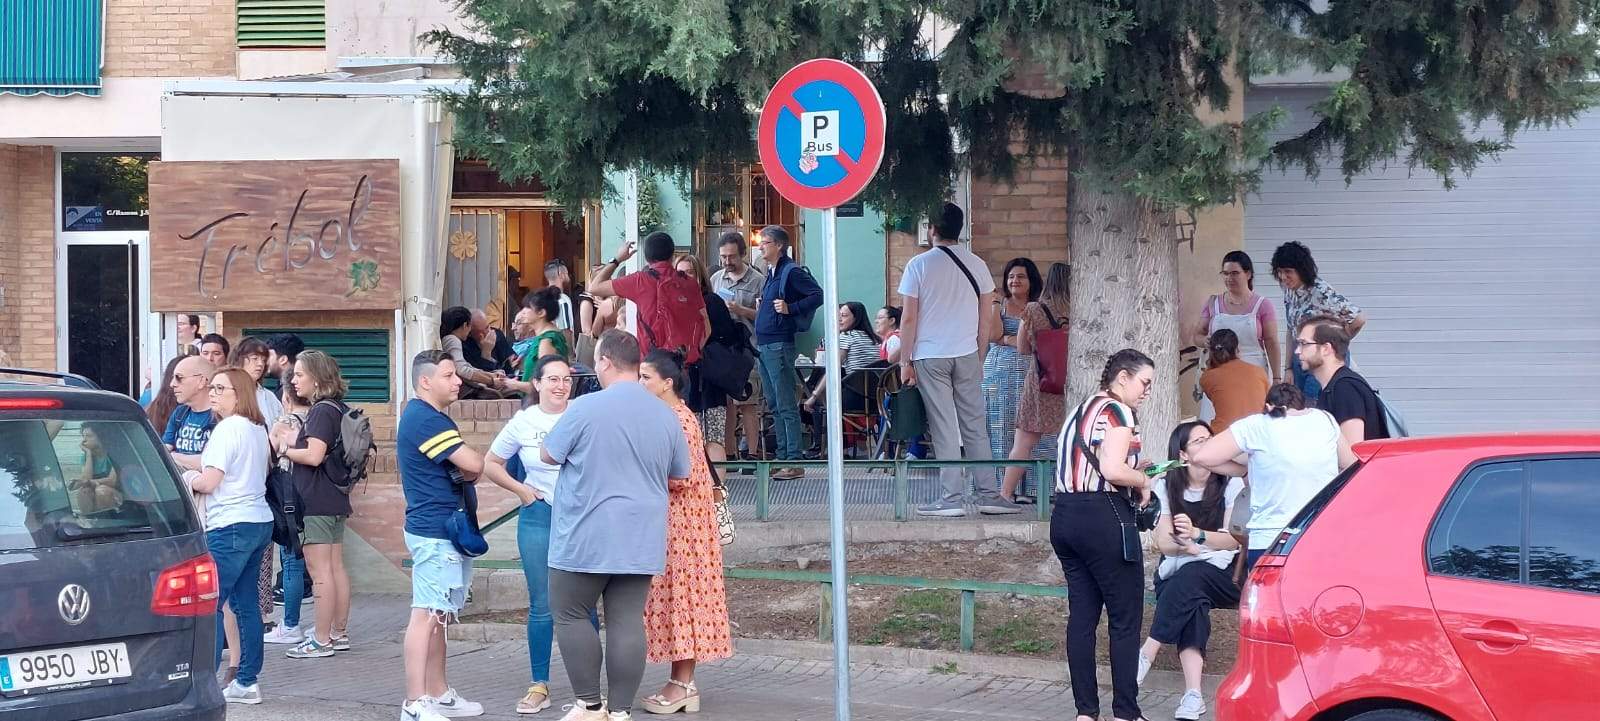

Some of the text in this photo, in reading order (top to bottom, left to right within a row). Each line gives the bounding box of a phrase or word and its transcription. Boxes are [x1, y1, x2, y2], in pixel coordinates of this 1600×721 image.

[814, 115, 829, 138] P
[807, 141, 833, 152] Bus
[178, 174, 372, 298] Trébol
[20, 648, 119, 682] 9950 JBY
